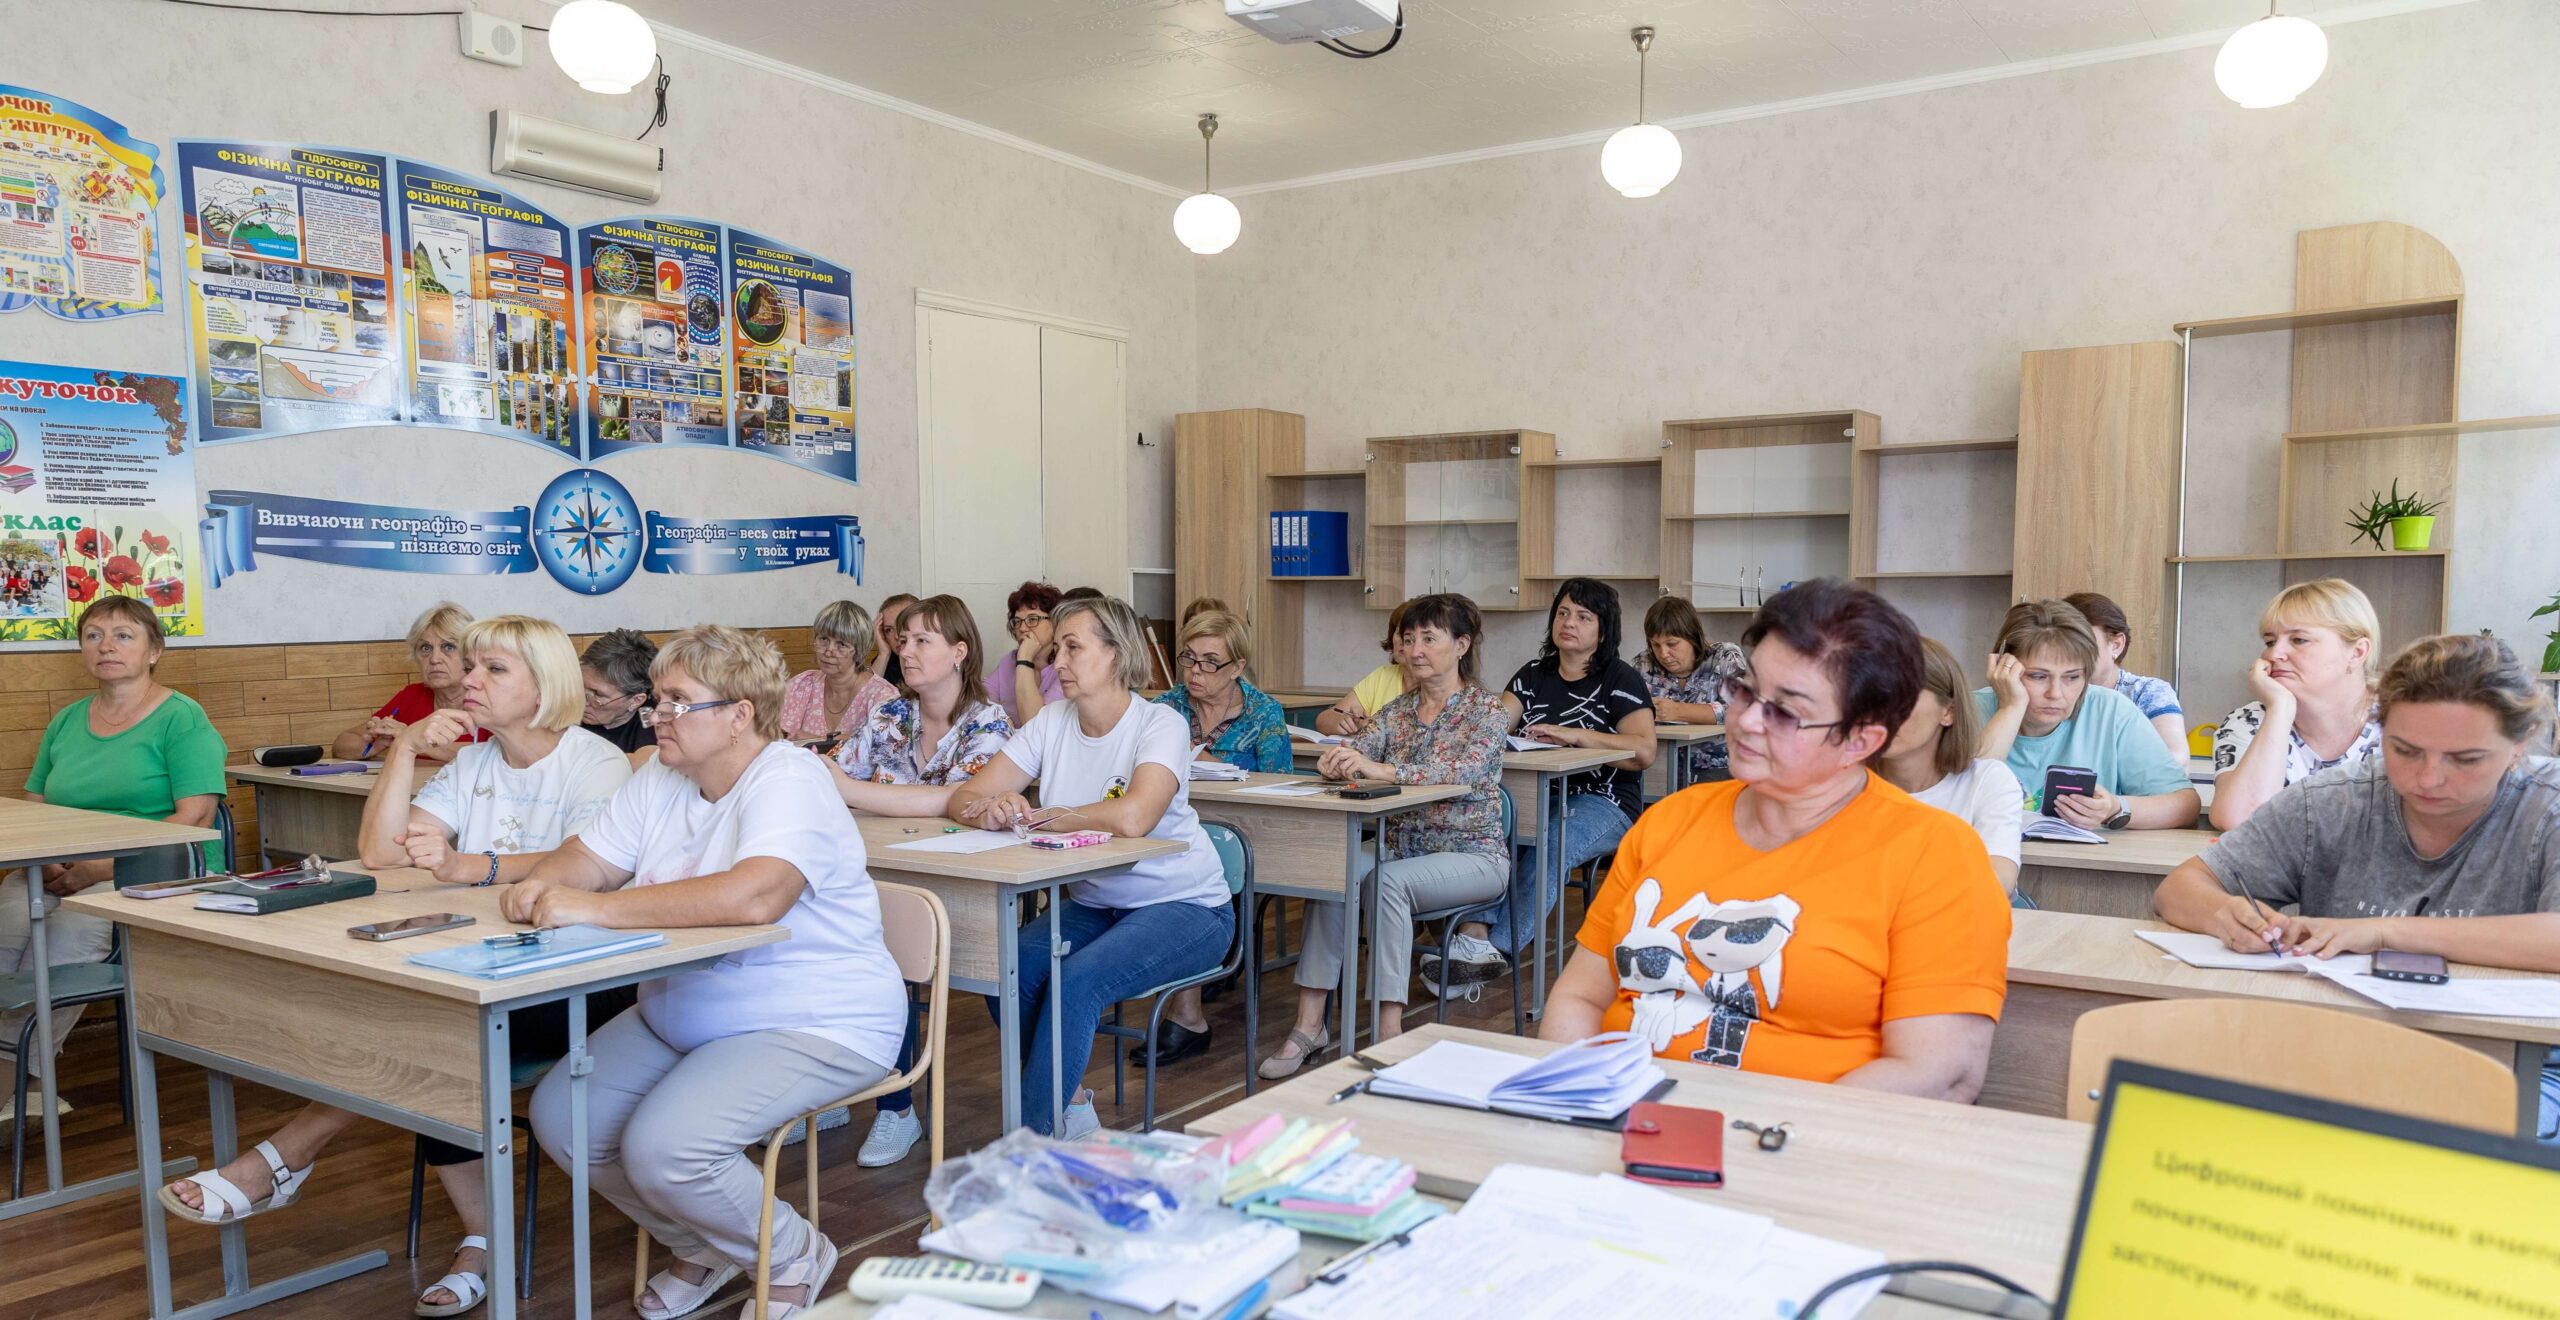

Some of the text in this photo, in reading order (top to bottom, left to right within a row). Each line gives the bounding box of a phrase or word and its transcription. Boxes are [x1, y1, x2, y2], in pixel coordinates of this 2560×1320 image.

[9, 119, 92, 145] ЖИТТЯ
[217, 150, 381, 190] ФІЗИЧНА ГЕОГРАФІЯ
[302, 152, 368, 173] ГІДРОСФЕРА
[324, 181, 344, 190] ВОДИ
[351, 187, 381, 197] ПРИРОДІ
[431, 182, 479, 198] БІОСФЕРА
[406, 190, 469, 211] ФІЗИЧНА
[472, 202, 543, 225] ГЕОГРАФІЯ
[603, 225, 717, 254] ФІЗИЧНА ГЕОГРАФІЯ
[656, 224, 705, 239] АТМОСФЕРА
[735, 258, 833, 284] ФІЗИЧНА ГЕОГРАФІЯ
[228, 279, 263, 290] СКЛАД
[0, 379, 138, 404] куточок
[3, 515, 82, 531] клас
[257, 509, 364, 529] Вивчаючи
[371, 516, 467, 537] географію
[655, 524, 726, 543] Географія
[739, 528, 768, 539] весь
[772, 526, 798, 540] світ
[400, 537, 521, 556] пізнаємо світ
[739, 544, 830, 560] у твоїх руках
[2154, 1149, 2304, 1201] Цифровий
